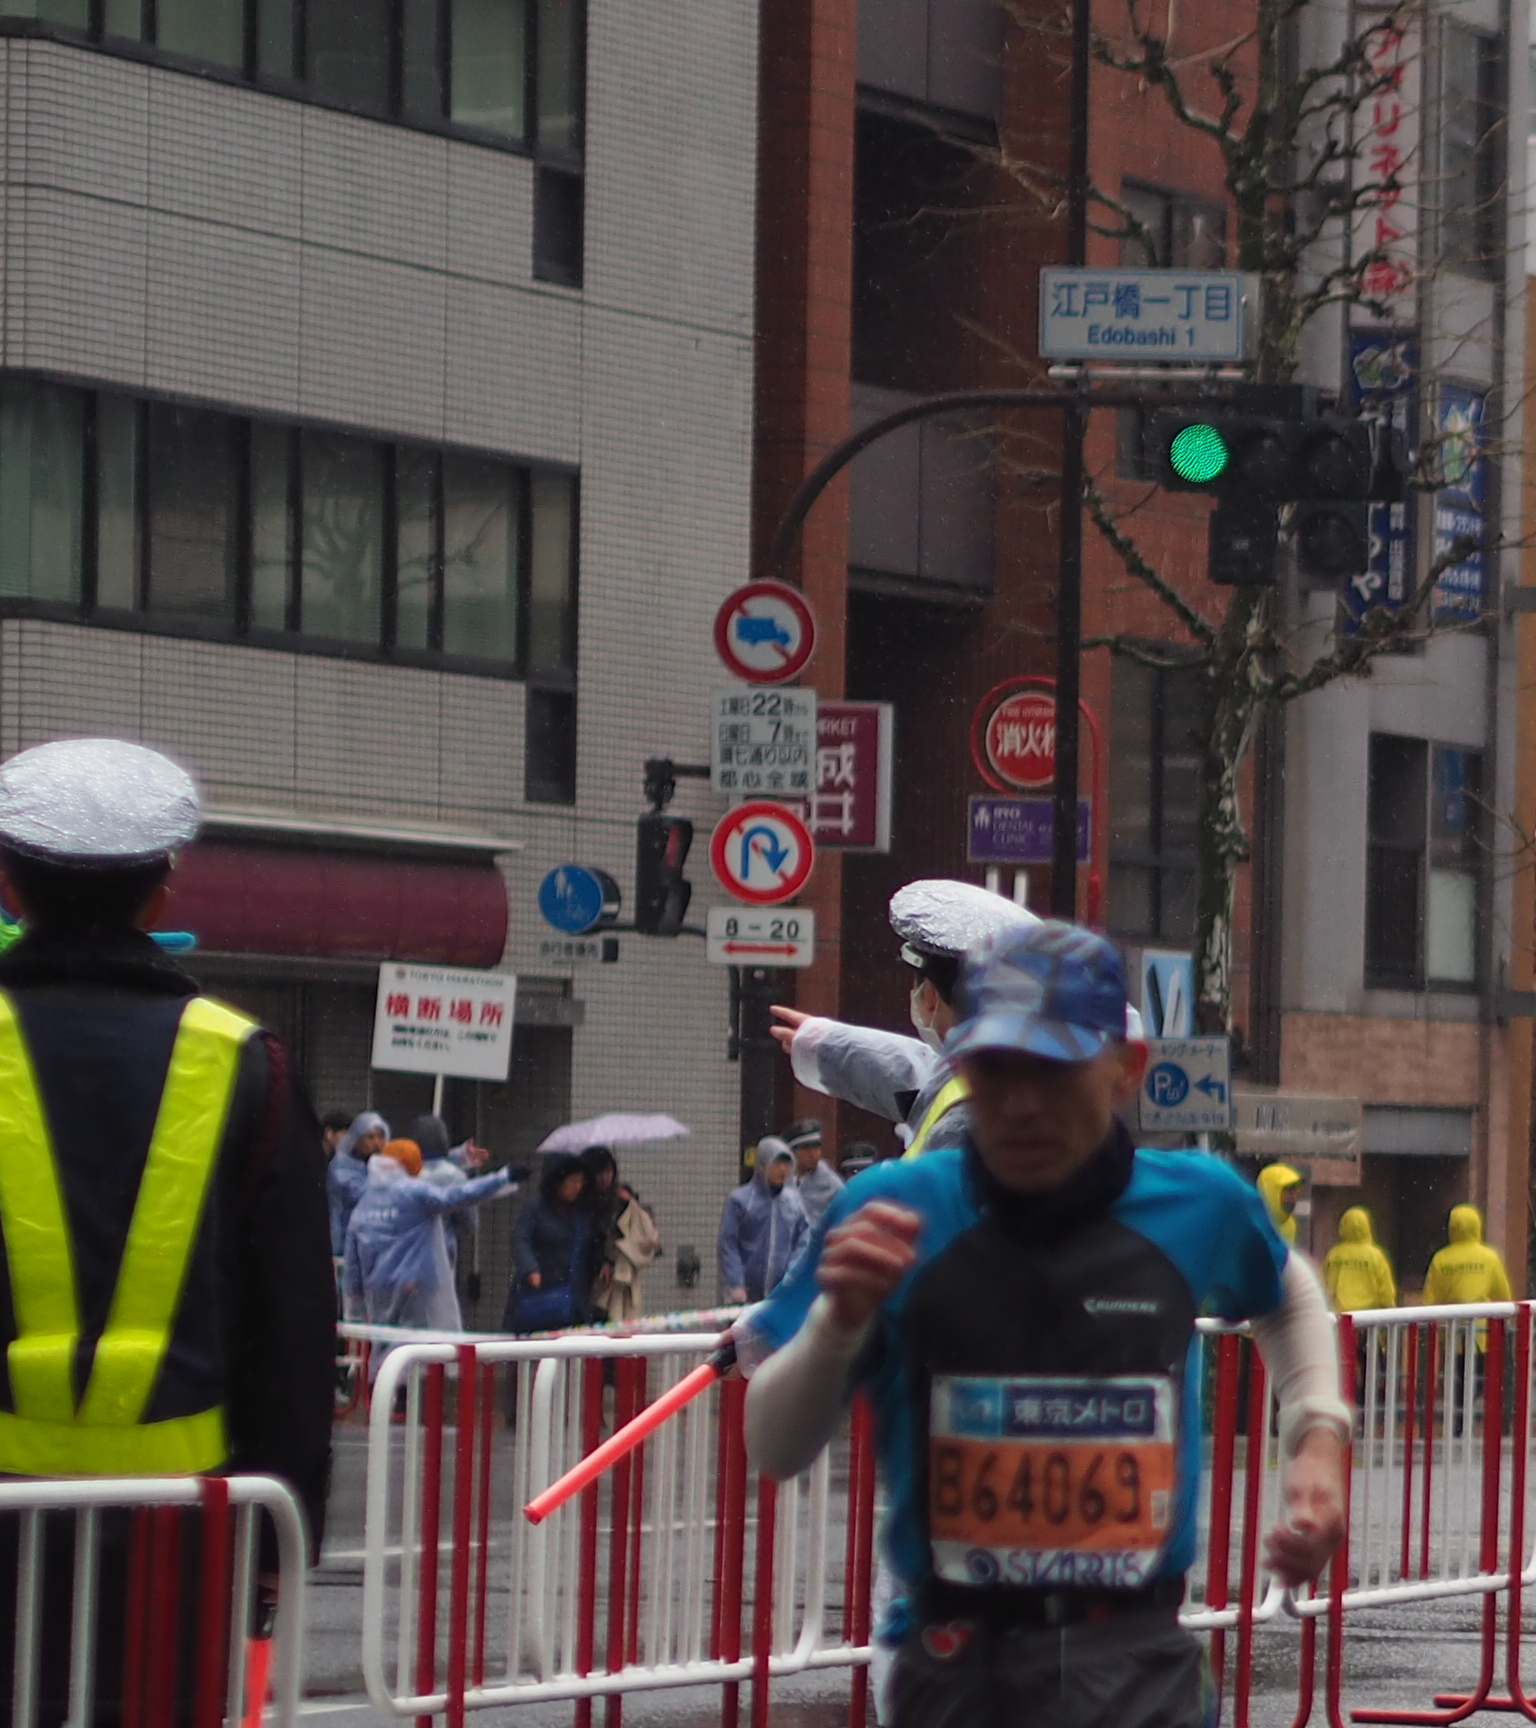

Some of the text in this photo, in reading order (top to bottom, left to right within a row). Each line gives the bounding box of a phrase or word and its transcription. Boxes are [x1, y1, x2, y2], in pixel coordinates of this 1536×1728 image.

[1052, 281, 1230, 321] 江戸橋一丁目
[1087, 324, 1195, 348] Edobashi 1
[386, 992, 503, 1028] 横断場所
[1149, 1042, 1222, 1057] ーキングメーター
[1013, 1398, 1146, 1425] 東京メトロ
[933, 1447, 1140, 1525] B64069
